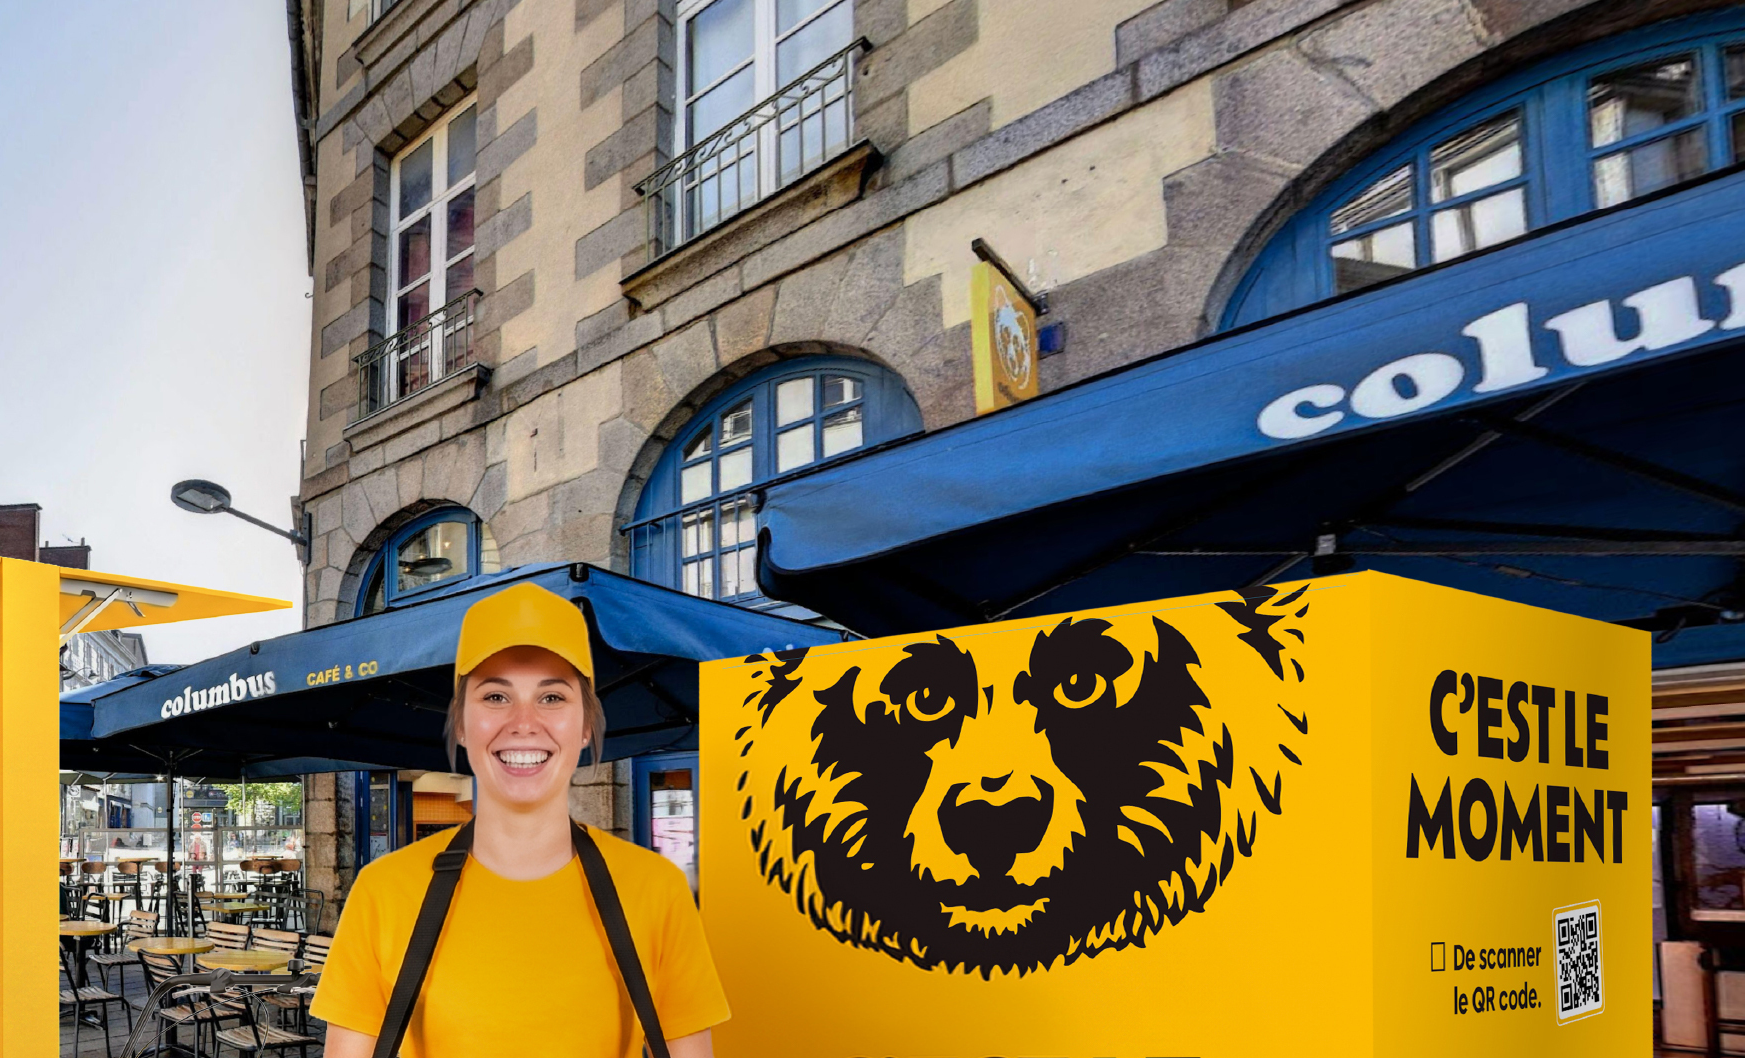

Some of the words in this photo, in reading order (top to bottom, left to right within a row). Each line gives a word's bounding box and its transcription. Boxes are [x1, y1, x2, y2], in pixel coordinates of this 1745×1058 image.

[160, 670, 277, 719] columbus
[306, 664, 340, 687] CAFÉ
[344, 664, 353, 680] &
[357, 660, 379, 677] CO
[1430, 669, 1556, 764] C'EST
[1564, 689, 1610, 770] LE
[1405, 771, 1628, 864] MOMENT
[1454, 944, 1477, 971] De
[1478, 944, 1542, 971] scanner
[1454, 985, 1469, 1015] le
[1472, 985, 1496, 1014] QR
[1499, 980, 1542, 1011] code.
